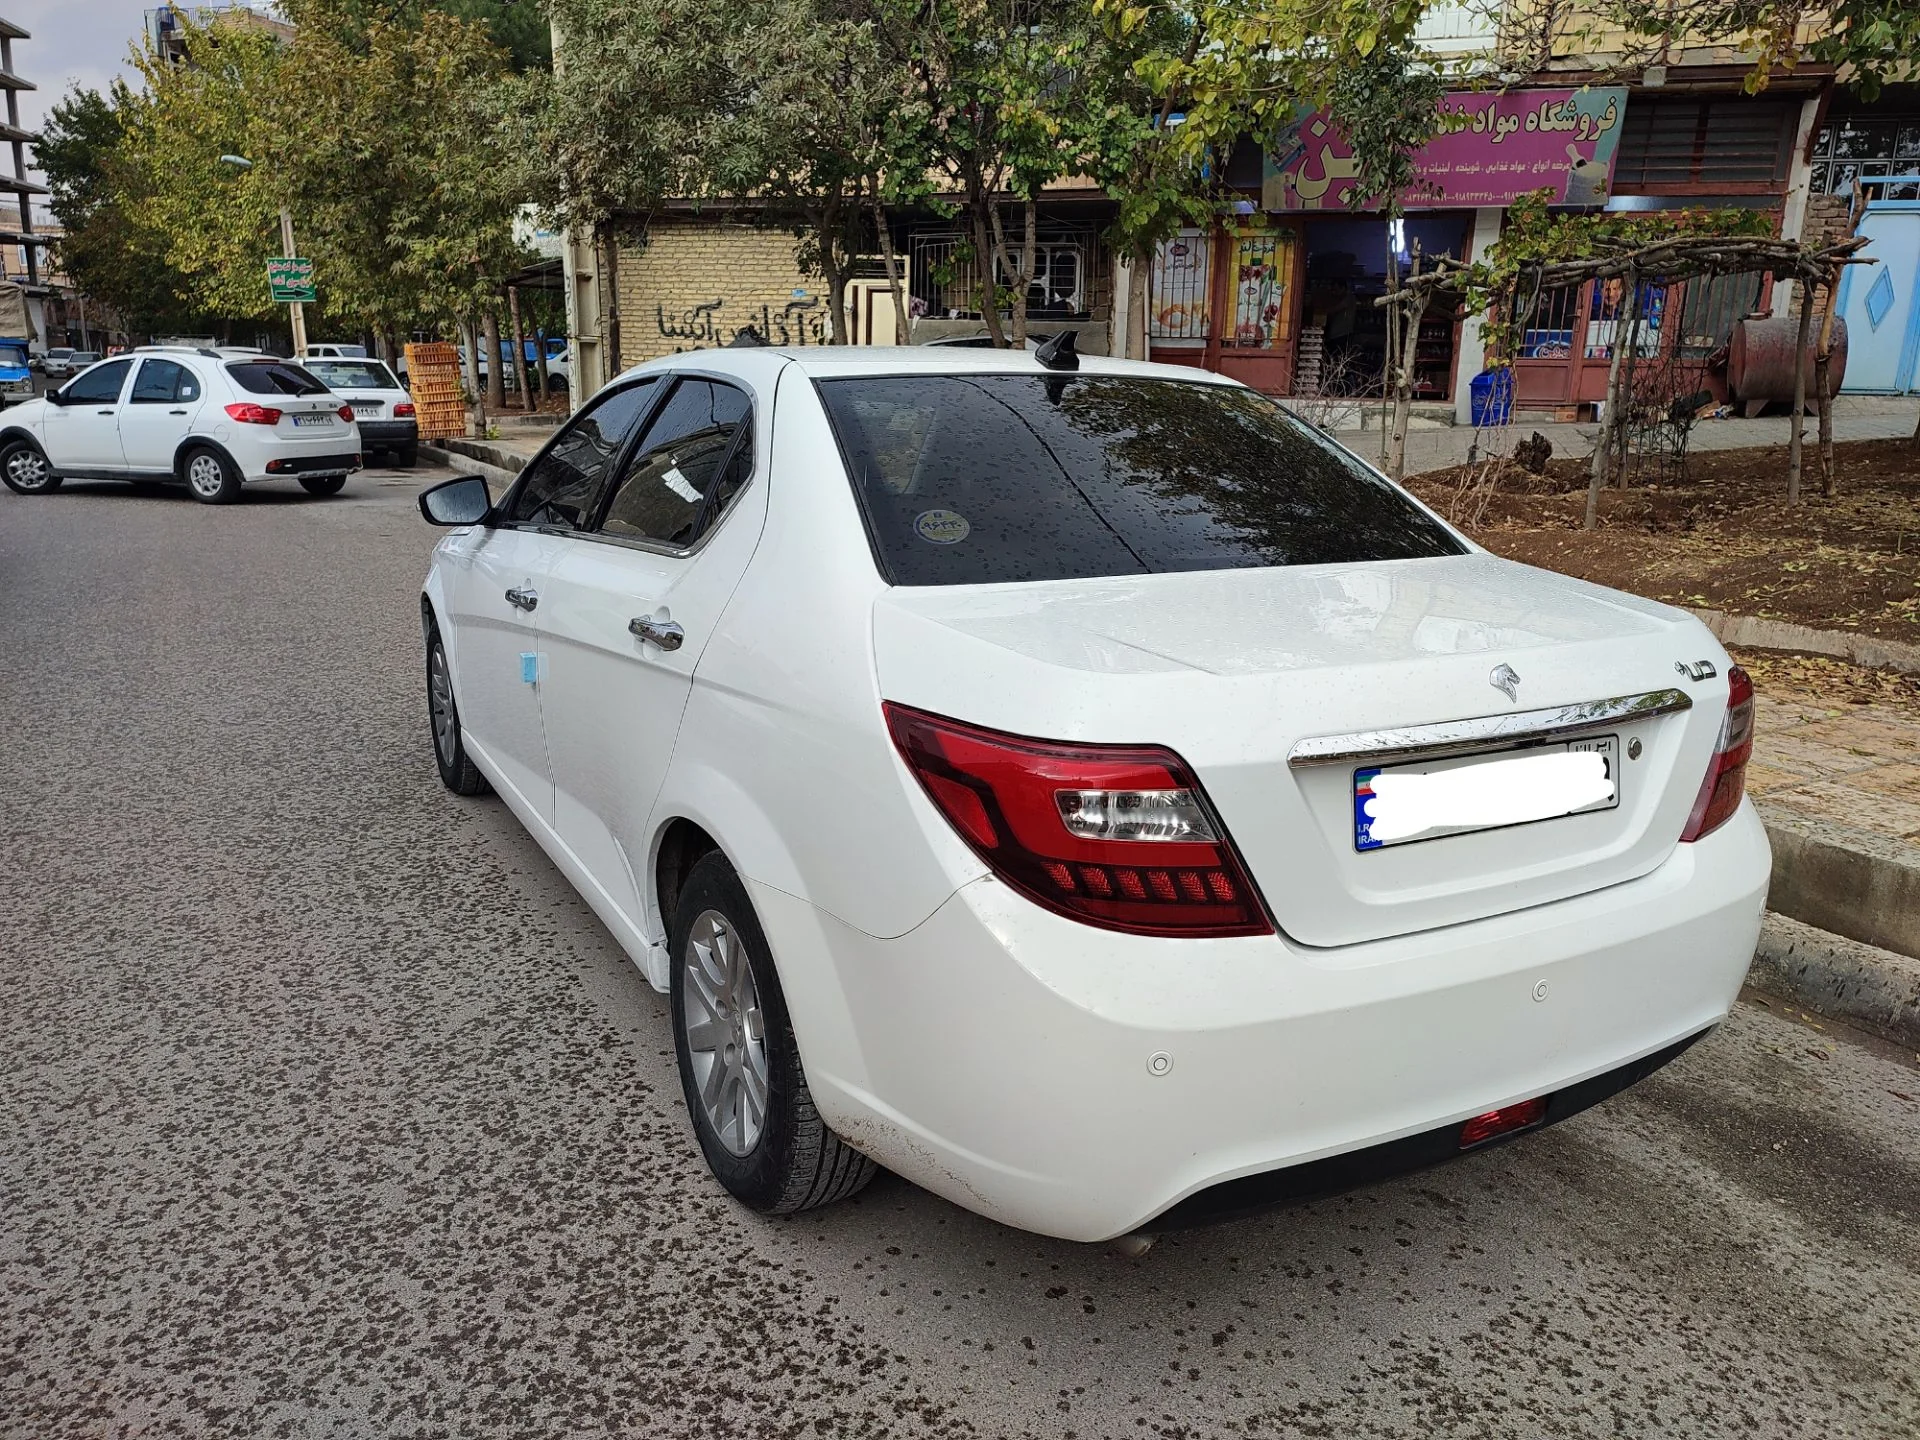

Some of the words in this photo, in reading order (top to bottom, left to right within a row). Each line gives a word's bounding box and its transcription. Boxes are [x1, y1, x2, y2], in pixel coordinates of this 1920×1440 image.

[1471, 101, 1520, 143] مواد
[1525, 96, 1617, 141] فروشگاه
[1510, 160, 1526, 173] مواد
[1532, 160, 1550, 174] انواع
[1358, 823, 1370, 833] I.R
[1358, 835, 1379, 845] IRA
